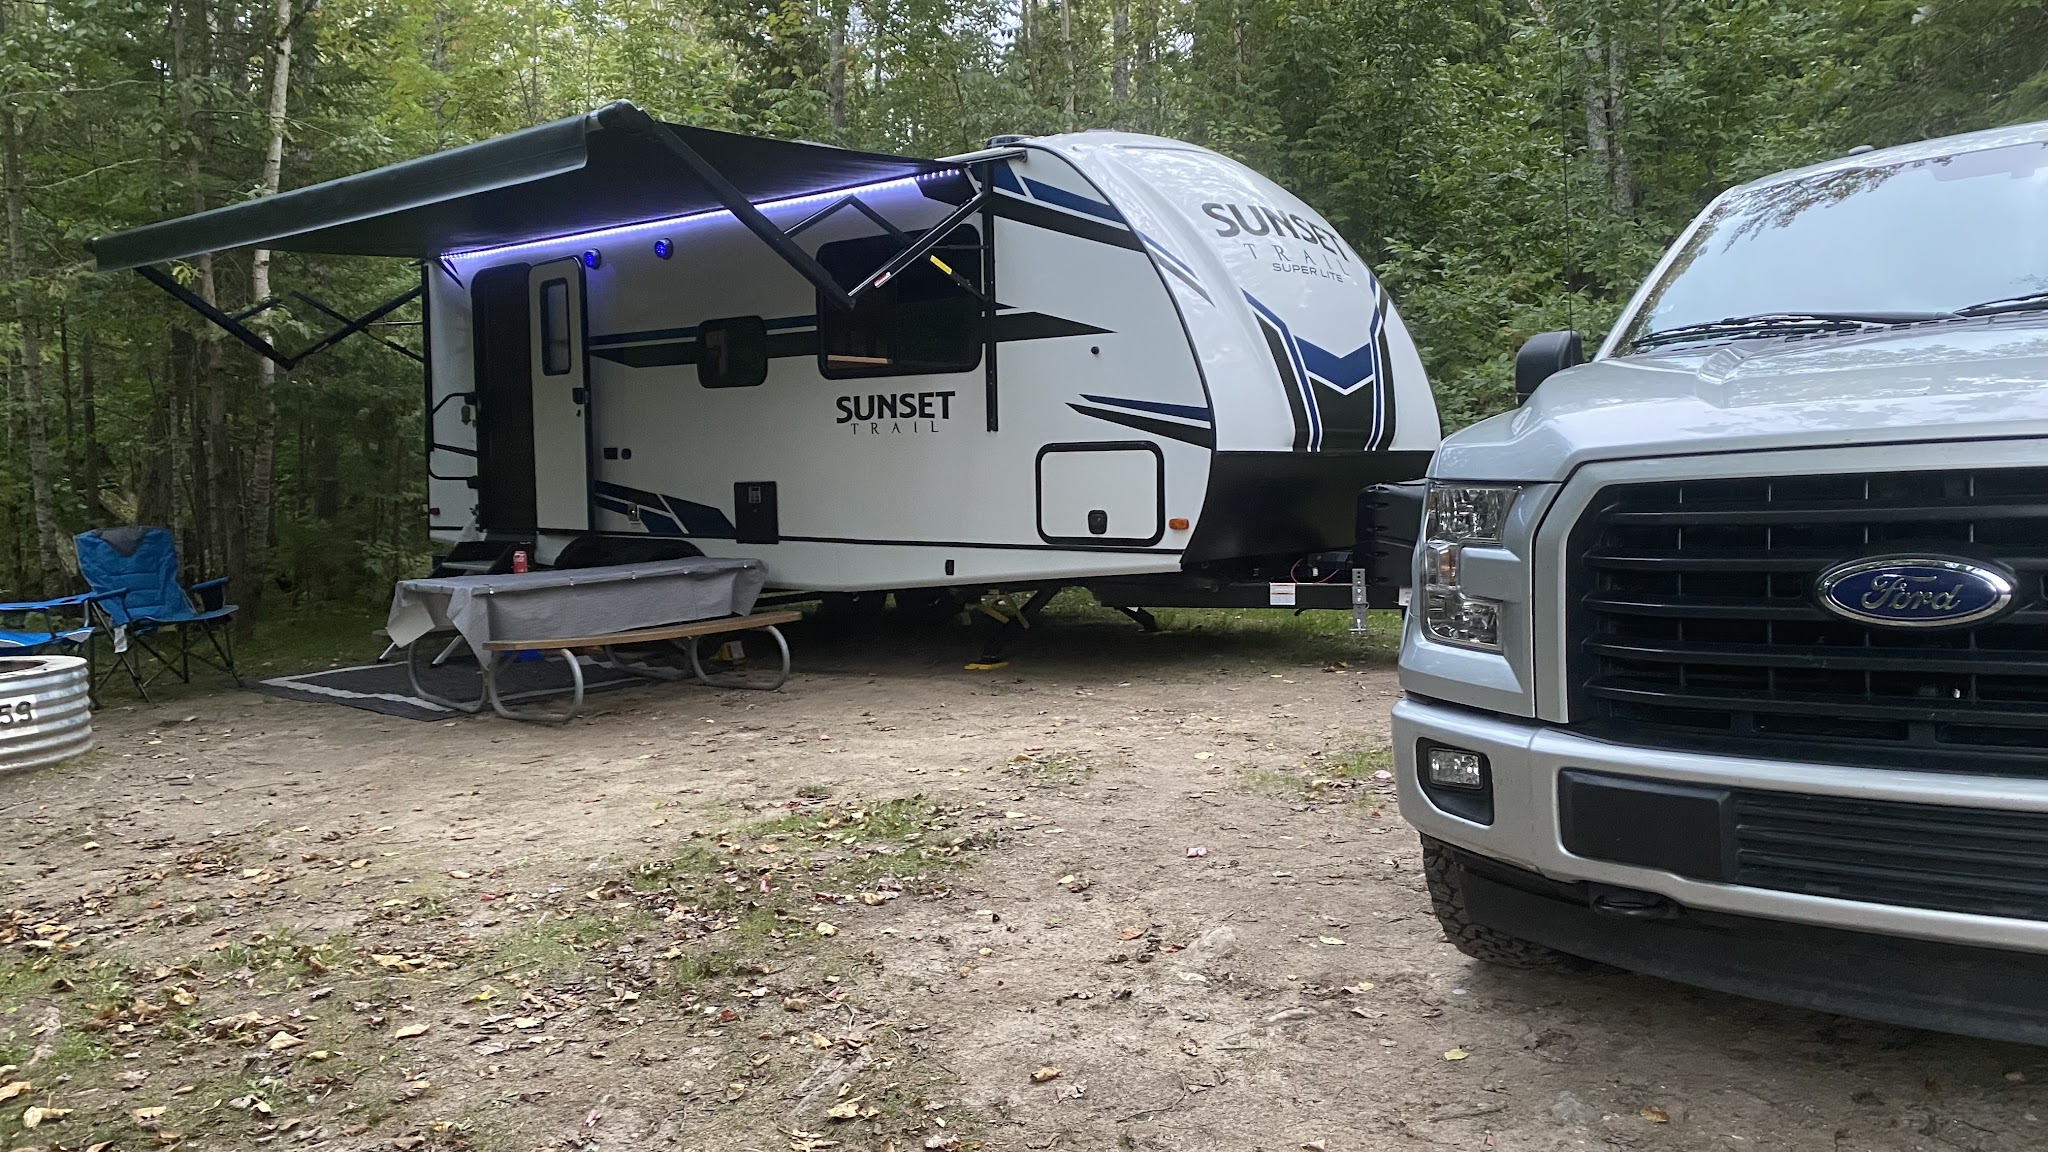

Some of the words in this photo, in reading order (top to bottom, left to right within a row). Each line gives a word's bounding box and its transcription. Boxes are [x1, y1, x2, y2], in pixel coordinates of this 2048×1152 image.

[1201, 203, 1349, 262] SUNSET
[1243, 243, 1350, 276] TRAIL
[1272, 262, 1317, 276] SUPER
[1320, 269, 1344, 283] LITE
[836, 391, 955, 424] SUNSET
[851, 420, 939, 435] TRAIL
[1861, 573, 1962, 610] Ford
